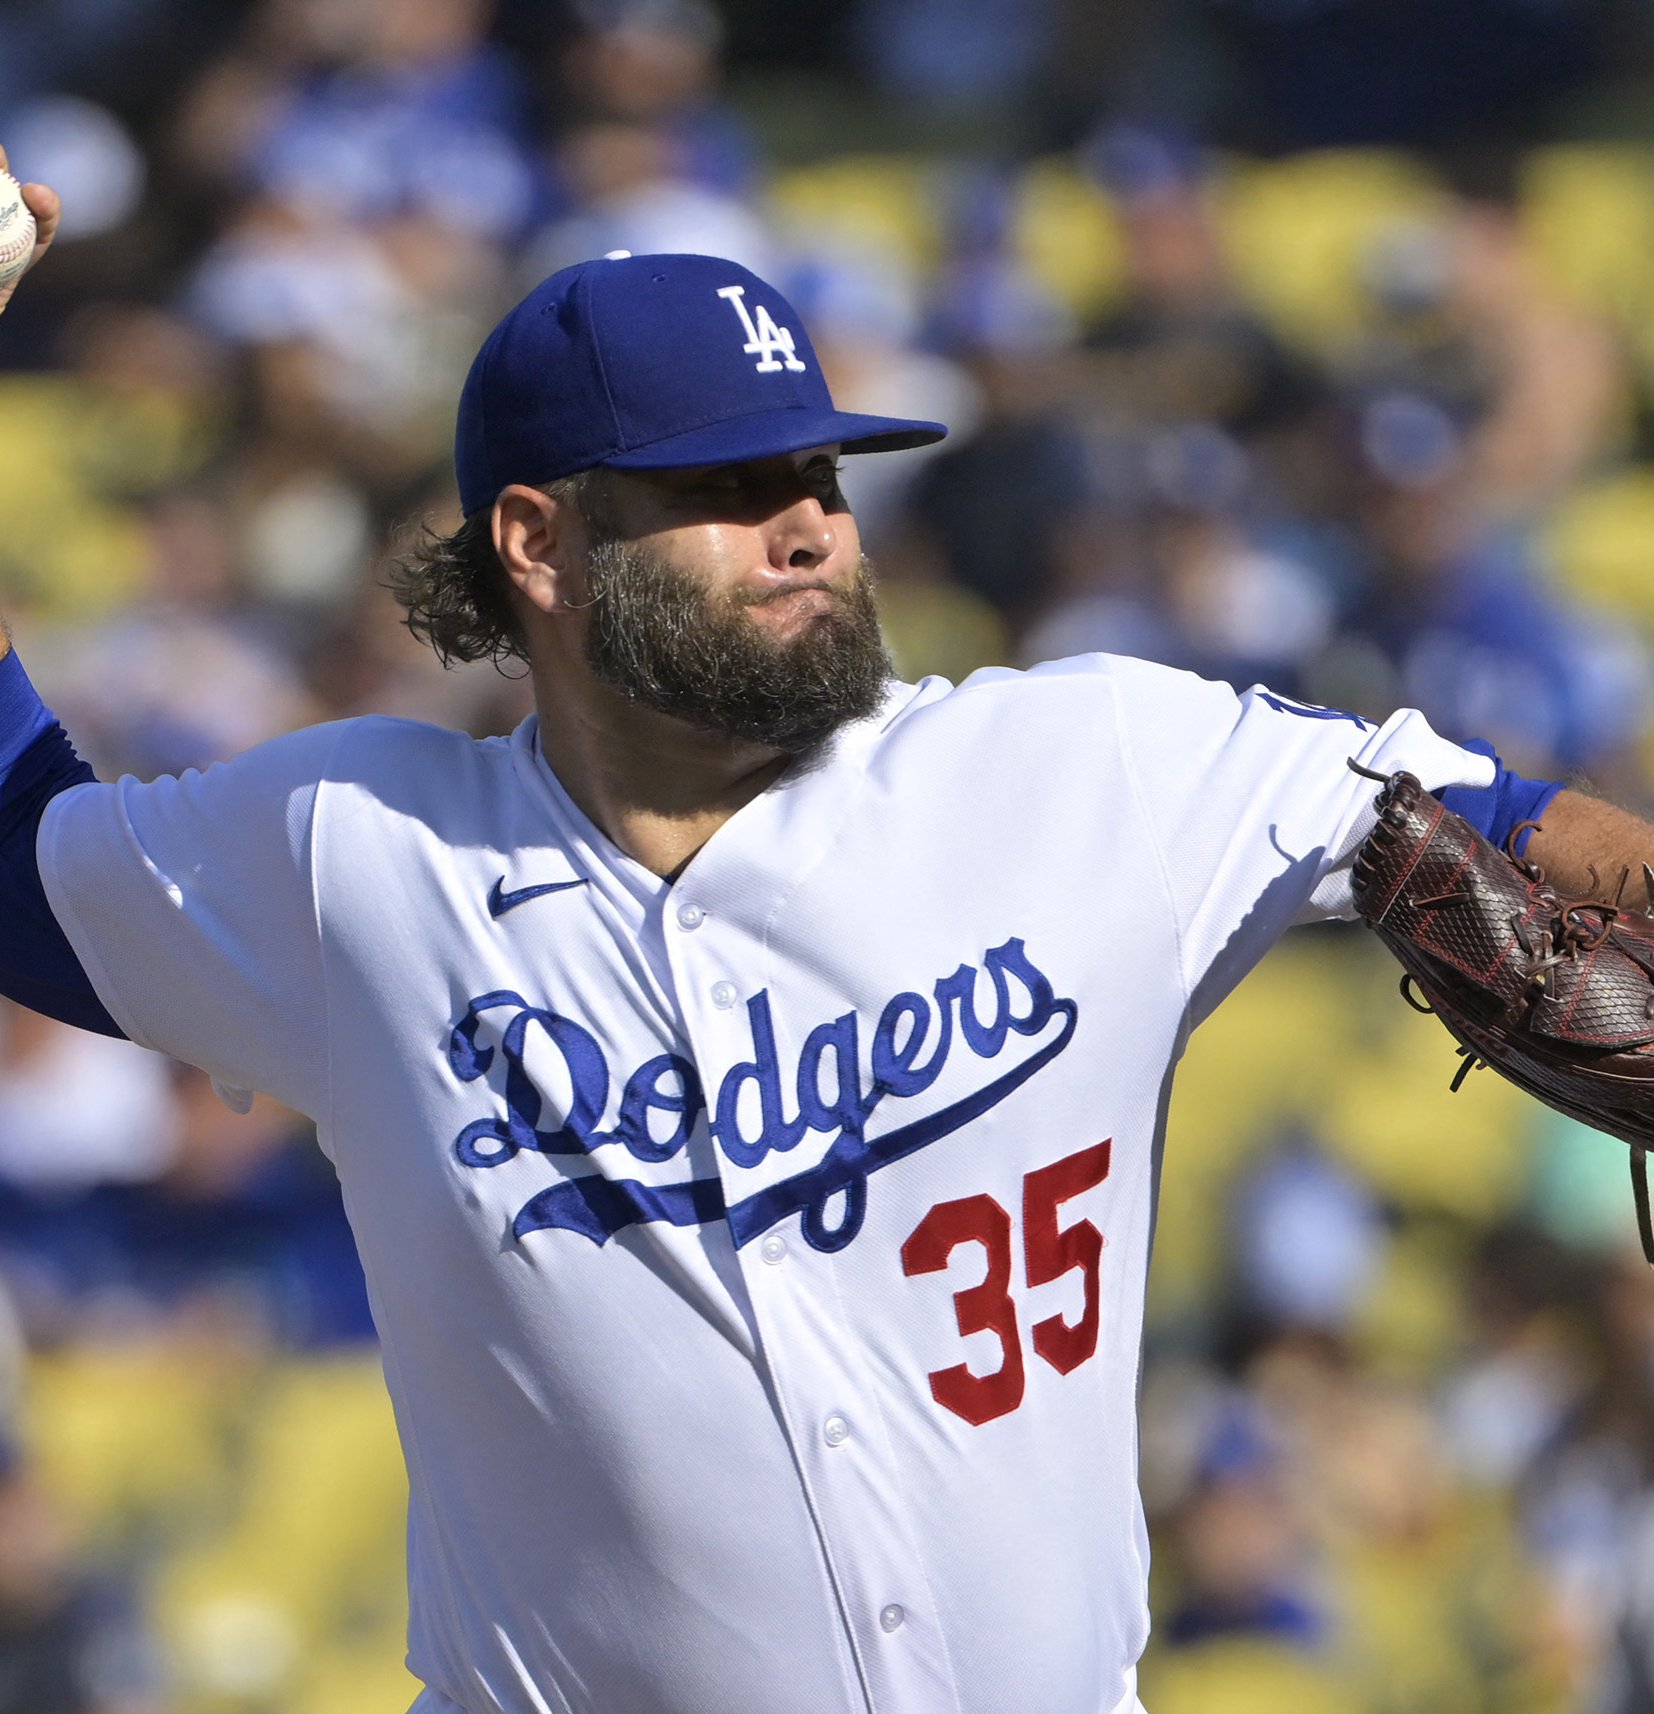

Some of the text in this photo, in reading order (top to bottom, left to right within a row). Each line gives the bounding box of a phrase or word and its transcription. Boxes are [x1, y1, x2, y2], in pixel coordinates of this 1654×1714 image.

[716, 286, 806, 373] LA
[449, 937, 1076, 1253] Dodgers
[900, 1137, 1112, 1427] 35
